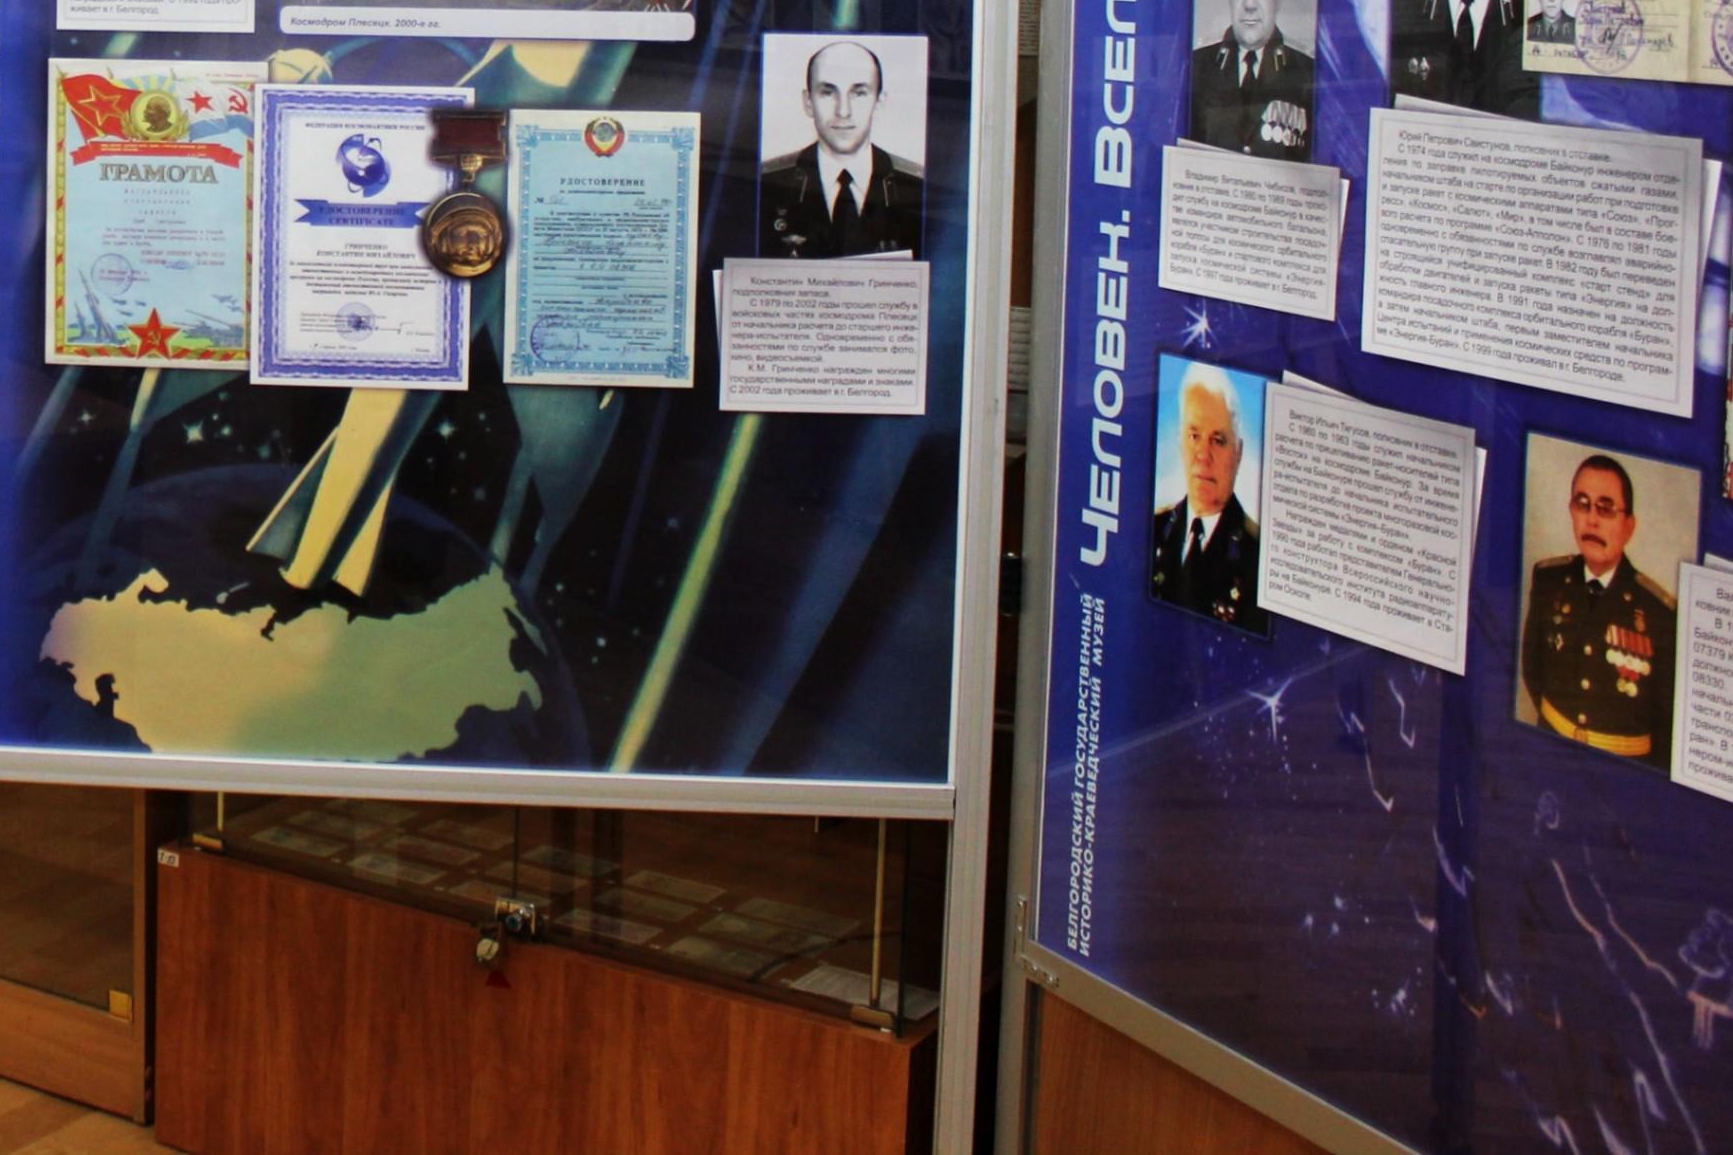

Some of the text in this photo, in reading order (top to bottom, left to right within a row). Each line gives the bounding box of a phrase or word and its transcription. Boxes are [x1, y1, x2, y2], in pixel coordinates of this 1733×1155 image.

[290, 17, 346, 28] Космодром
[99, 163, 219, 184] ГРАМОТА
[559, 177, 646, 187] УДОСТОВЕРЕНИЕ
[1066, 592, 1093, 951] БЕЛГОРОДСКИЙ ГОСУДАРСТВЕННЫЙ
[1078, 598, 1106, 957] ИСТОРИКО-КРАЕВЕДЧЕСКИЙ МУЗЕЙ
